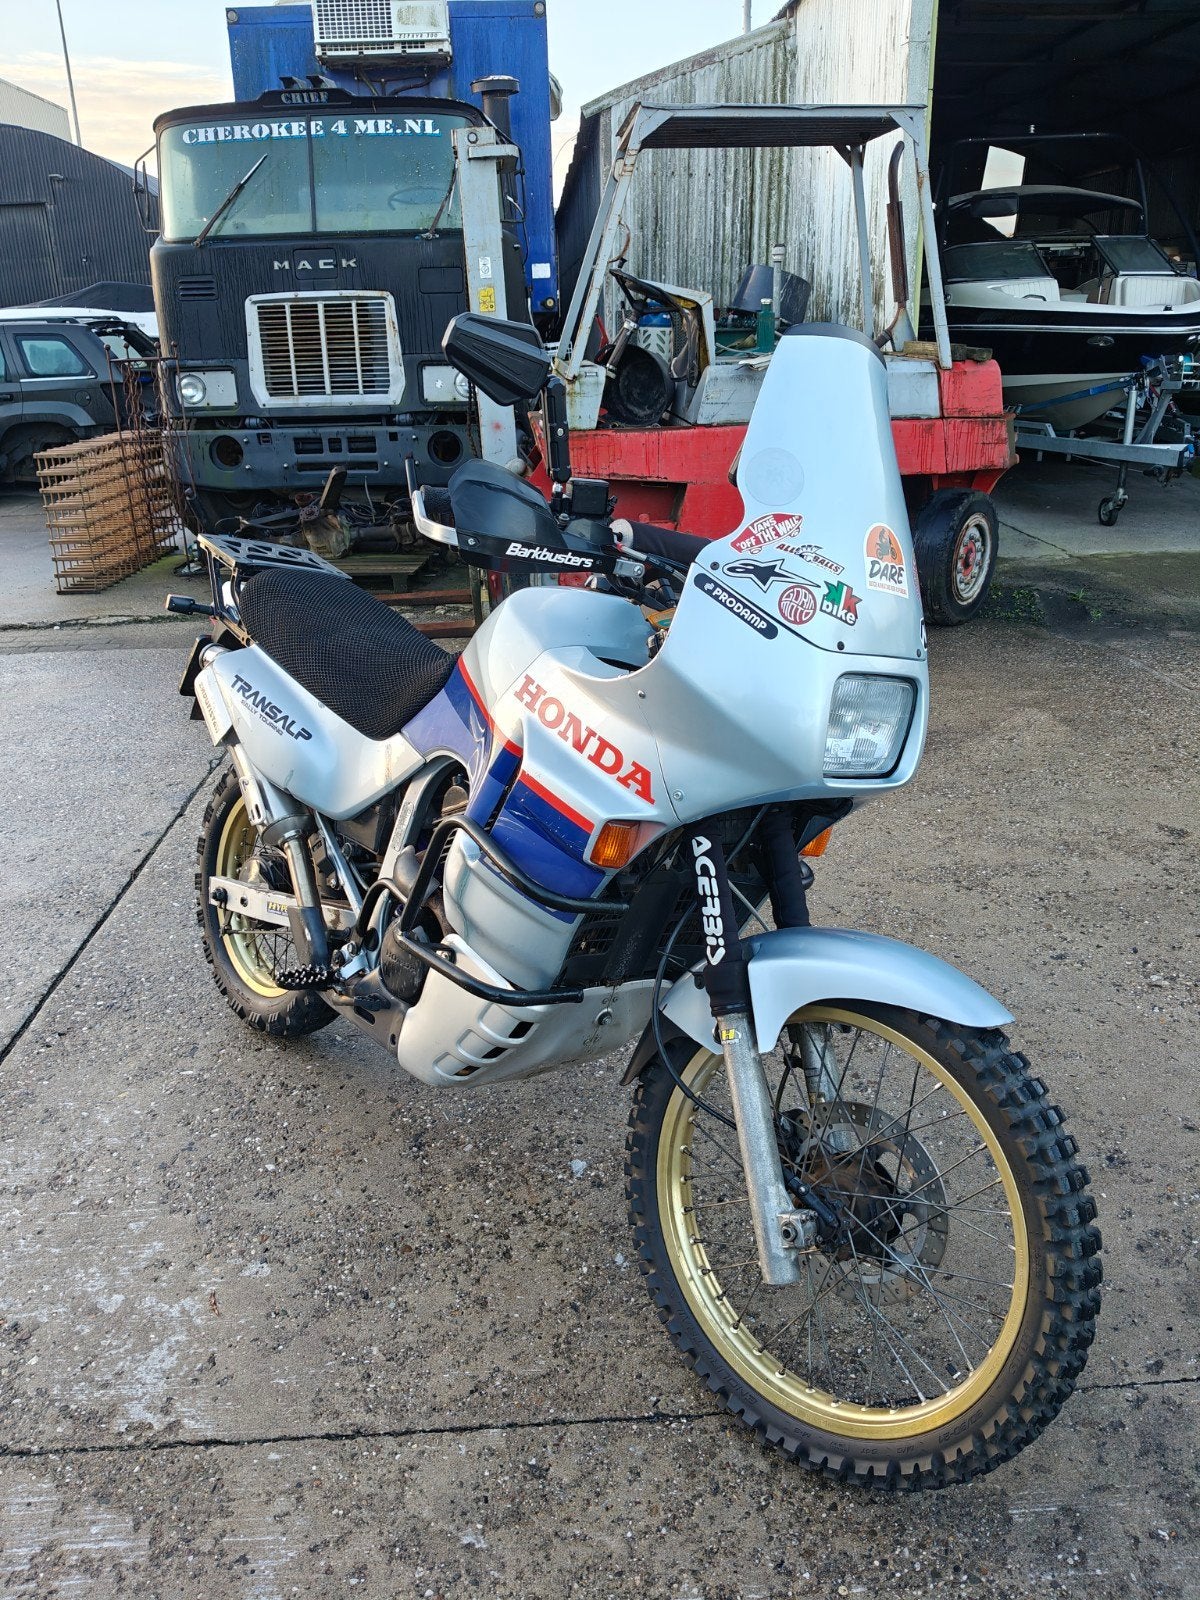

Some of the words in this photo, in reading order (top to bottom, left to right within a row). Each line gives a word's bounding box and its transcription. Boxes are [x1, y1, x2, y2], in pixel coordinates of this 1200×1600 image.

[280, 91, 329, 104] CHIEF
[182, 120, 325, 145] CHEROKEE
[331, 119, 348, 135] 4
[354, 118, 441, 136] ME.NL
[273, 257, 358, 271] MACK
[749, 515, 778, 534] VANS
[756, 525, 779, 544] THE
[505, 542, 594, 568] Barkbusters
[776, 543, 796, 555] ALL
[812, 555, 841, 573] BALLS
[869, 559, 905, 585] DARE
[711, 585, 768, 630] PRODAMP
[780, 601, 814, 622] MOTO
[821, 597, 856, 625] bike
[230, 674, 313, 741] TRANSALP
[240, 699, 258, 715] RALLY
[259, 714, 284, 736] TOURING
[514, 673, 656, 806] HONDA
[691, 835, 726, 966] ACERBIS
